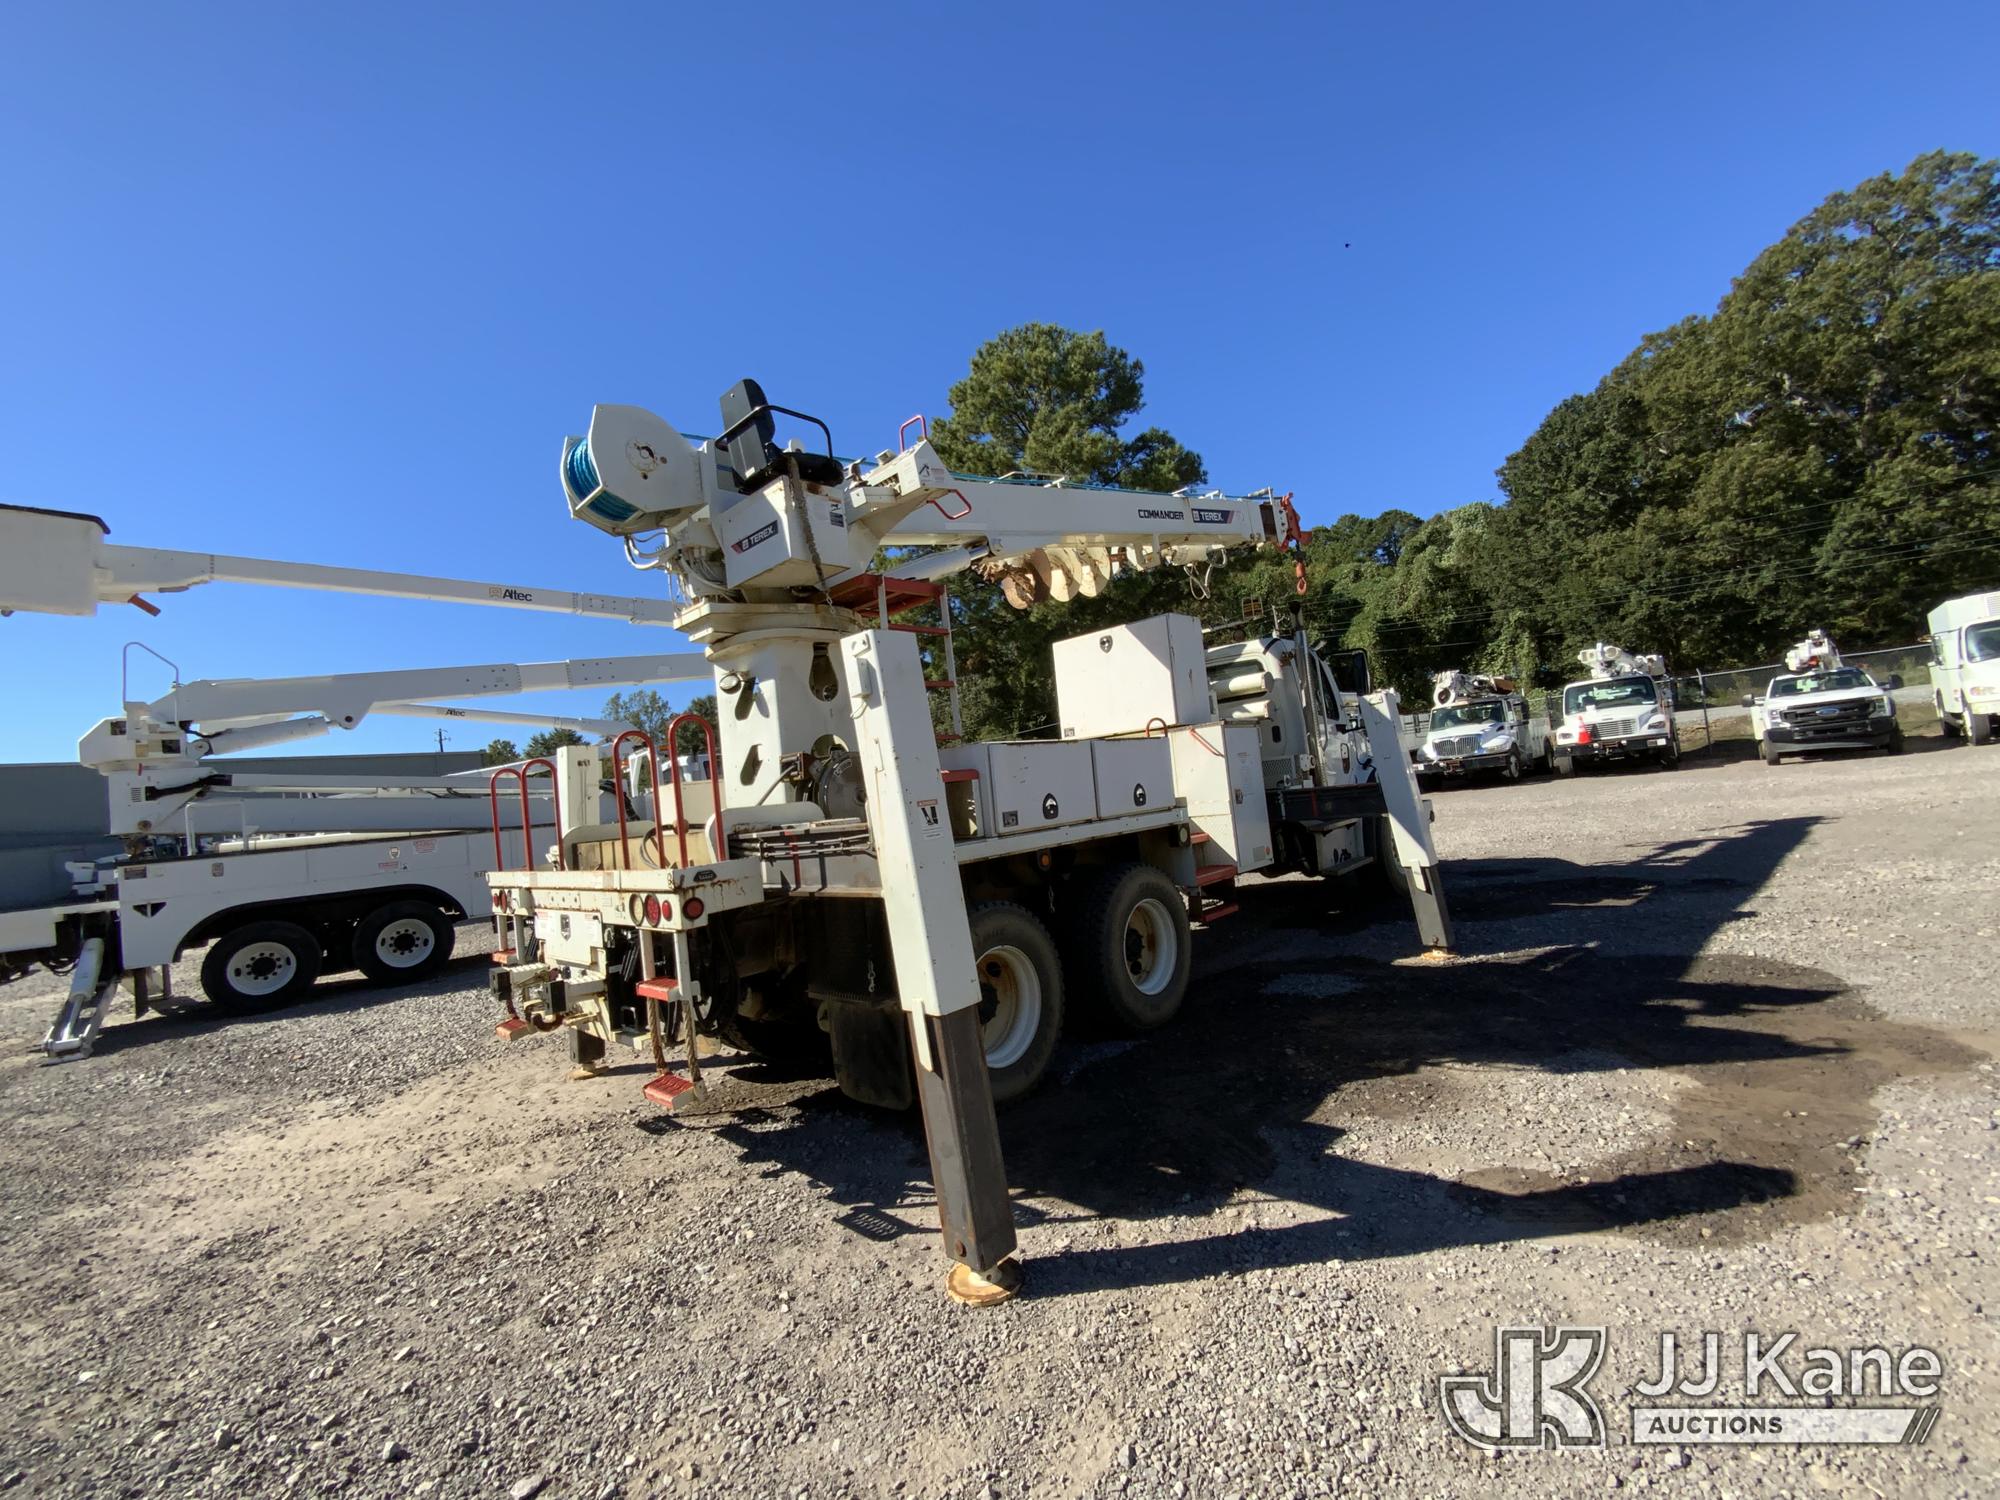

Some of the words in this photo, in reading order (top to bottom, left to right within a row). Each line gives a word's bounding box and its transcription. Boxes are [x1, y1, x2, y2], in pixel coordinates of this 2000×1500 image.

[1138, 509, 1184, 520] COMMANDER
[1201, 511, 1225, 521] TEREX
[750, 525, 774, 545] TEREX
[502, 589, 533, 602] Altec
